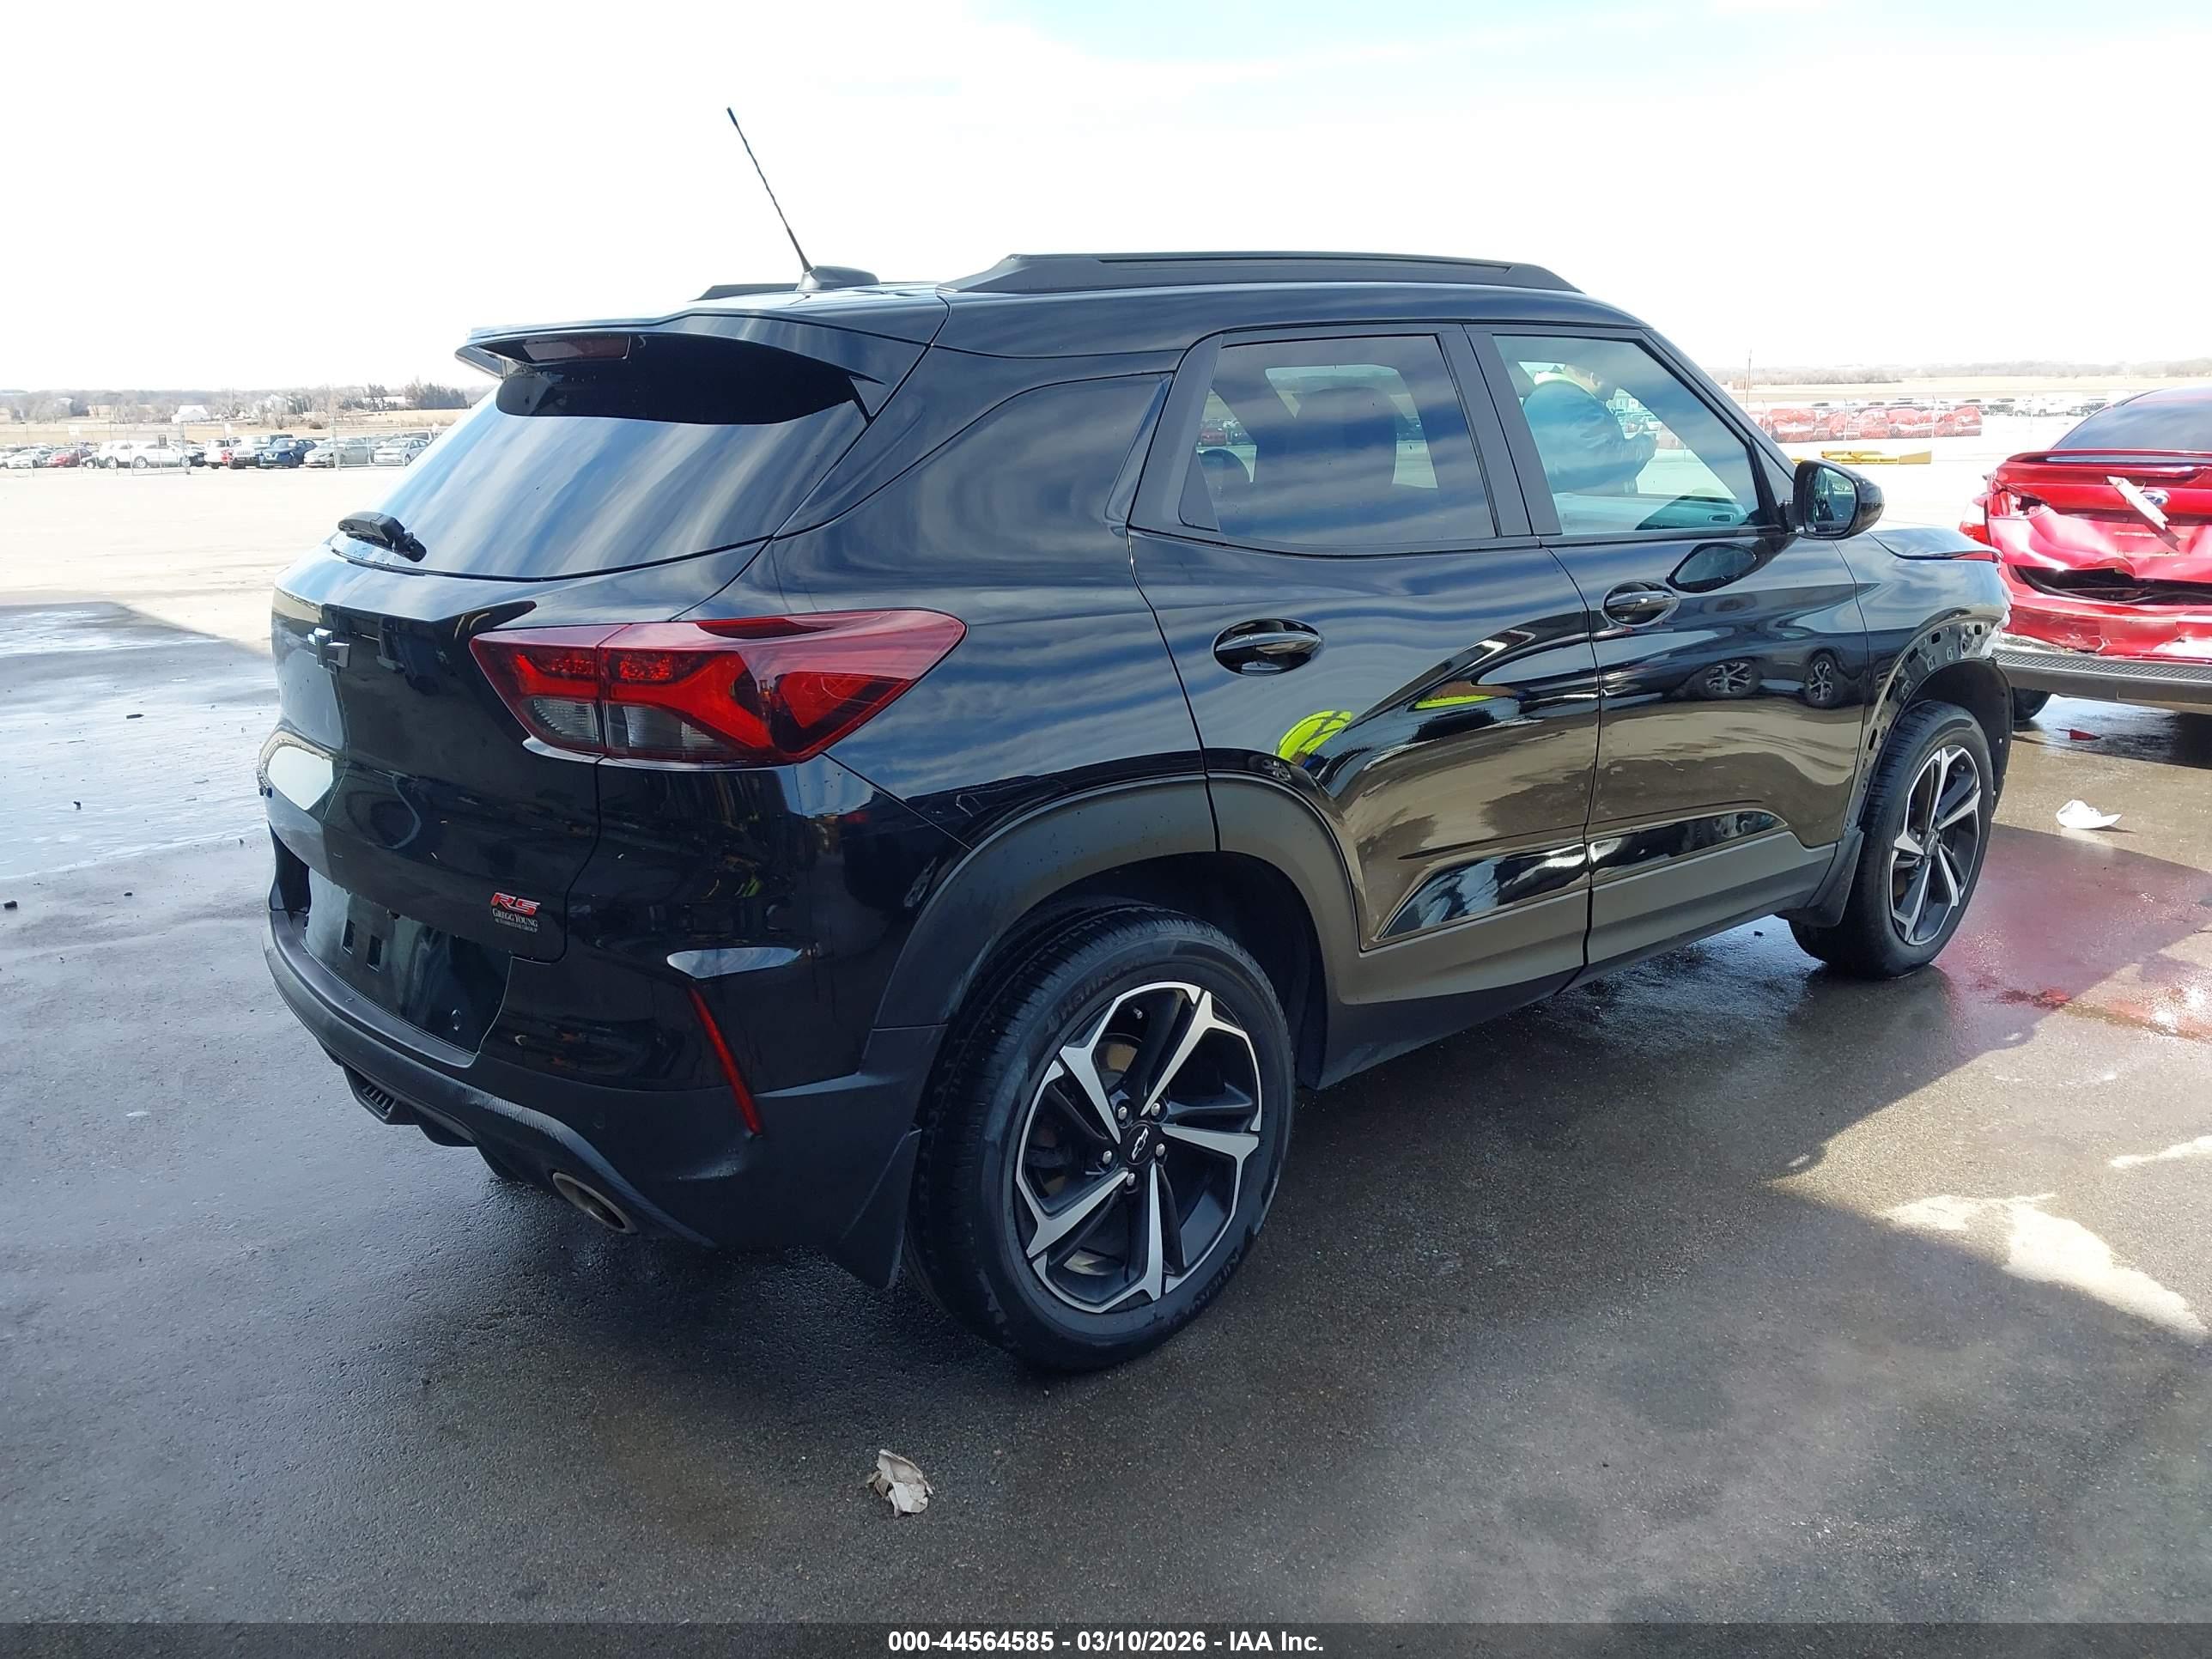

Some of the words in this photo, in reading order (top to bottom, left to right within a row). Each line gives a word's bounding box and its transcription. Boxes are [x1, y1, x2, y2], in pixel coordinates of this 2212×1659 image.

[490, 892, 541, 915] RS
[492, 908, 514, 921] GREGG
[514, 913, 538, 928] YOUNG
